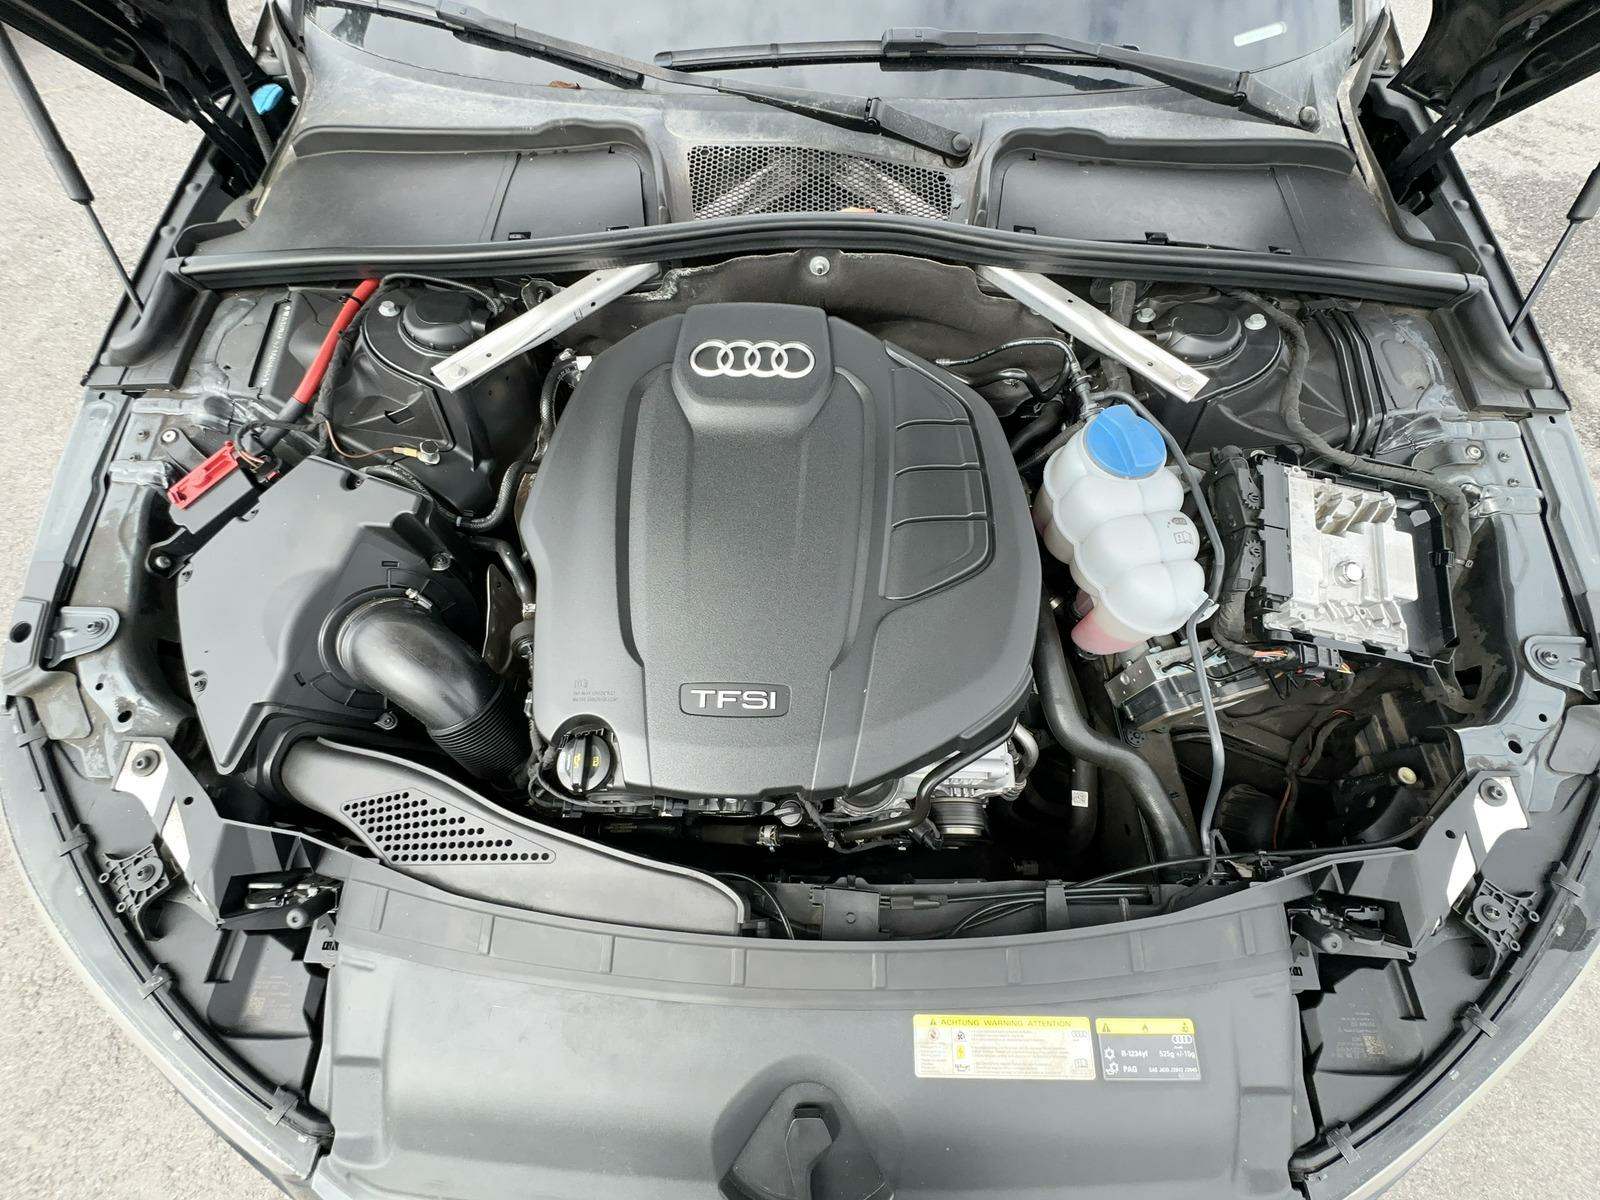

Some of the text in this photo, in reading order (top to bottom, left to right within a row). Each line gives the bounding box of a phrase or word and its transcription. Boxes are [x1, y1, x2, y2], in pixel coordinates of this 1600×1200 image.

[690, 690, 777, 710] TFSI
[941, 1018, 1072, 1028] ACHTUNG WARNING ATTENTION
